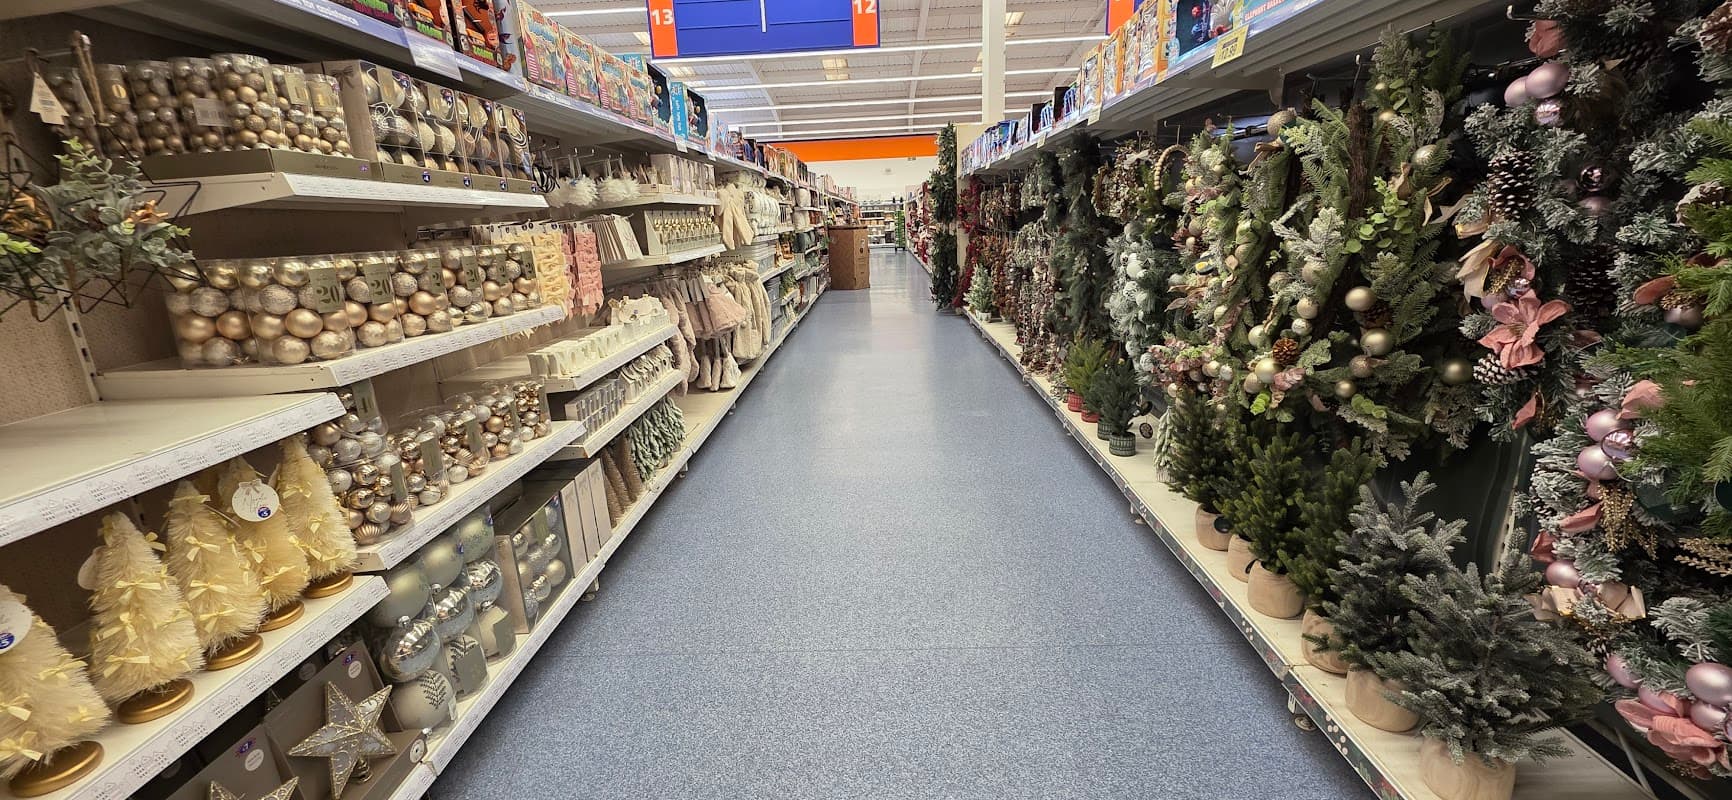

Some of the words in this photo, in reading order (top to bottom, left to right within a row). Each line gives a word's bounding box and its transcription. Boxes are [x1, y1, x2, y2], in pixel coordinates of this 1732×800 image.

[854, 0, 876, 14] 12
[651, 8, 674, 26] 13
[316, 284, 340, 305] 20
[370, 278, 391, 296] 20
